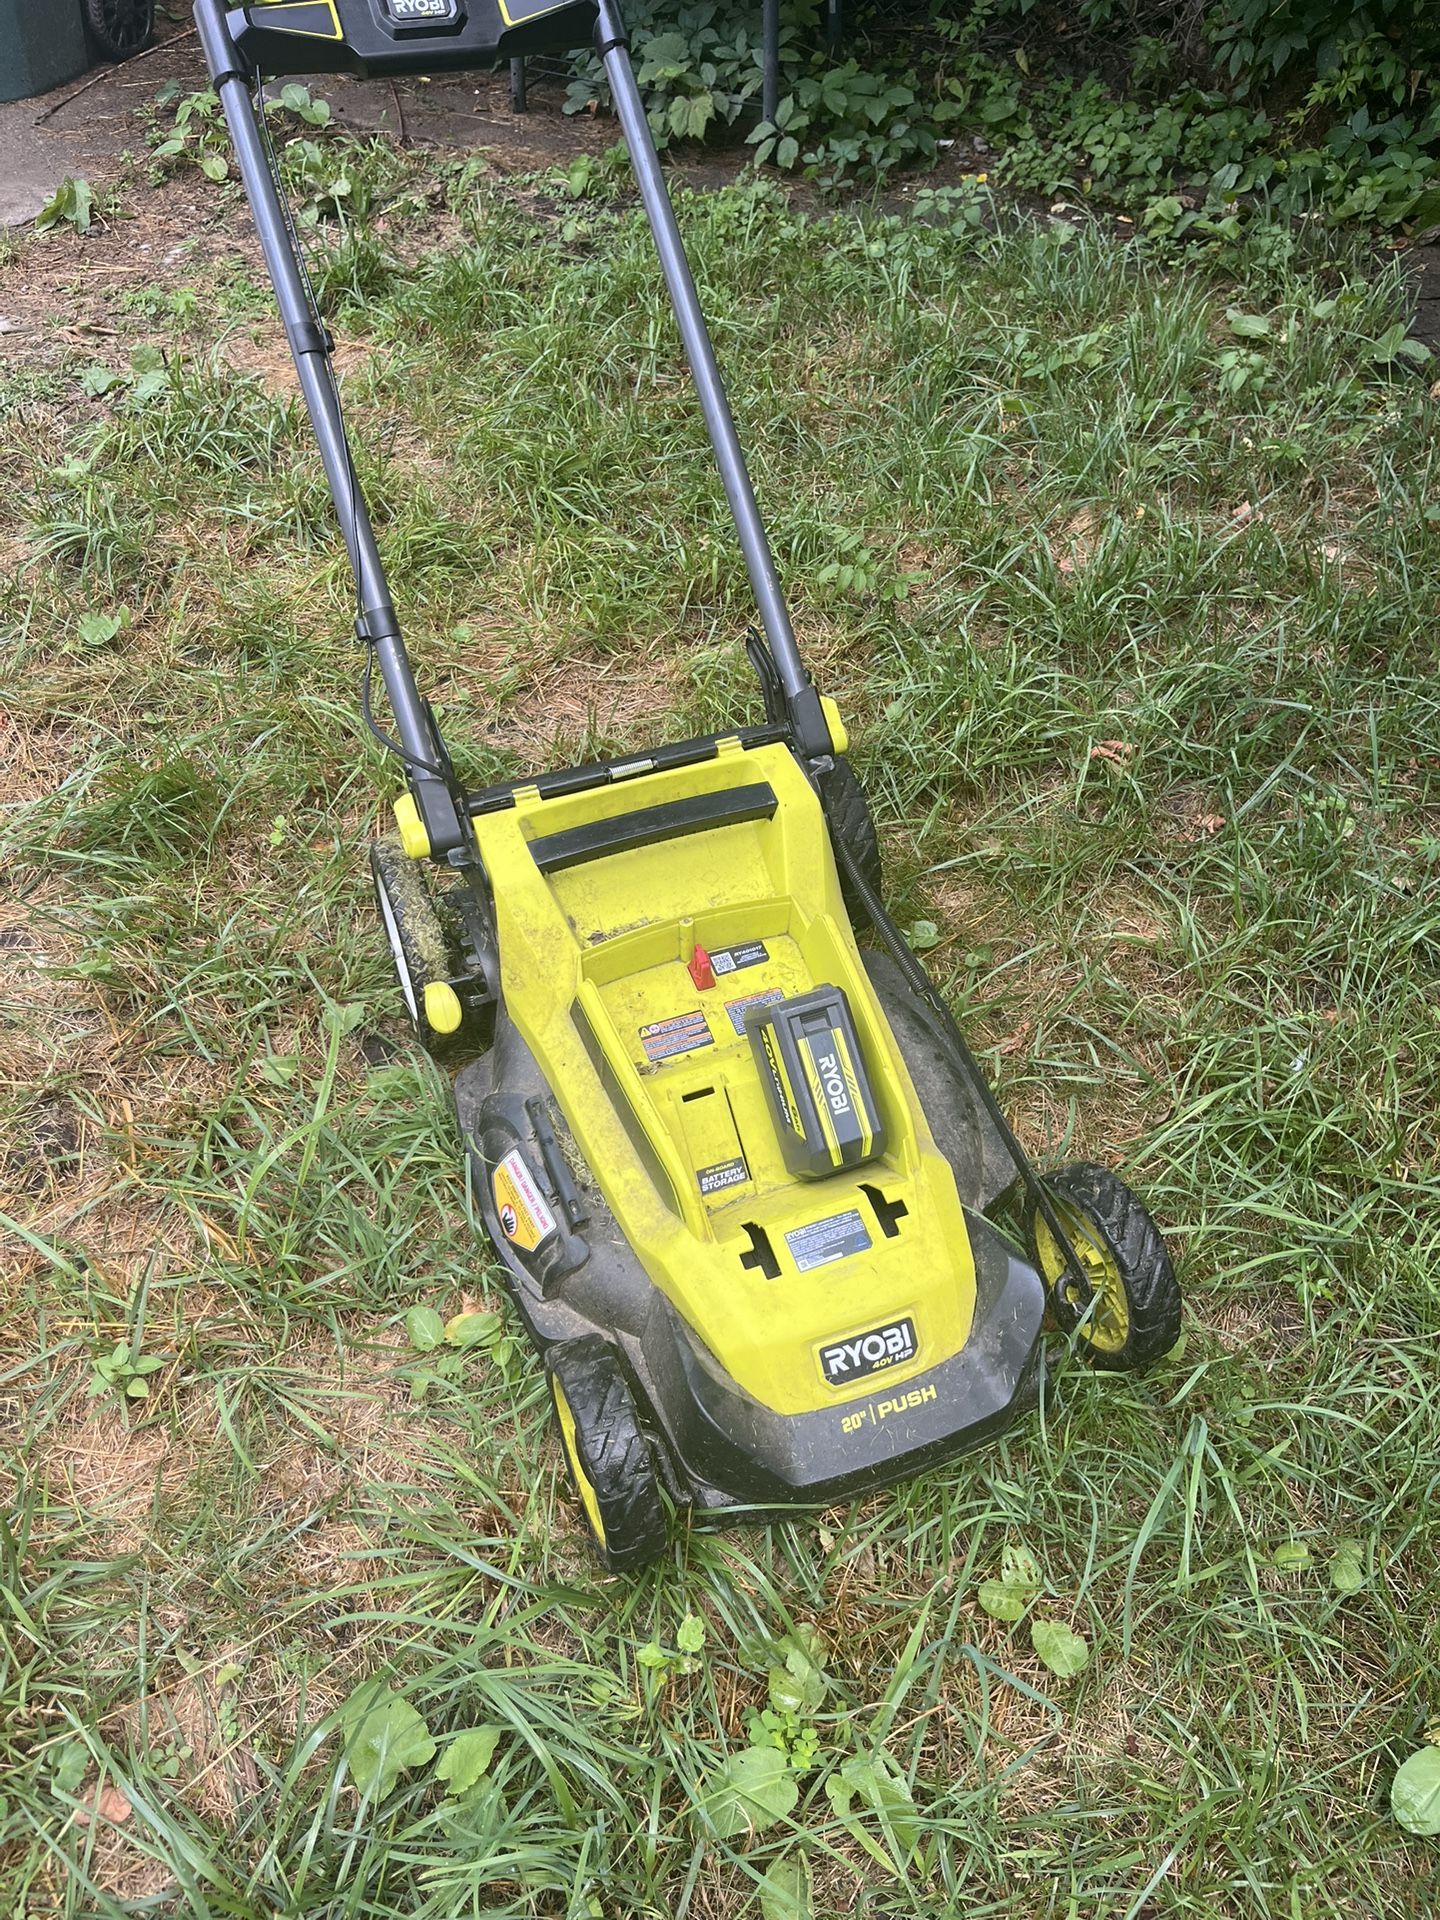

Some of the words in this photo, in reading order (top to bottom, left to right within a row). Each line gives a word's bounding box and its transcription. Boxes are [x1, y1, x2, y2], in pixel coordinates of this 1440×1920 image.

[393, 0, 446, 13] RYOBI
[761, 1029, 777, 1070] 40V
[819, 1053, 850, 1115] RYOBI
[701, 1166, 742, 1185] BATTERY
[701, 1172, 746, 1192] STORAGE
[824, 1323, 912, 1376] RYOBI
[872, 1355, 894, 1370] 40V
[894, 1348, 914, 1362] HP
[841, 1411, 866, 1434] 20"
[877, 1384, 938, 1419] PUSH
